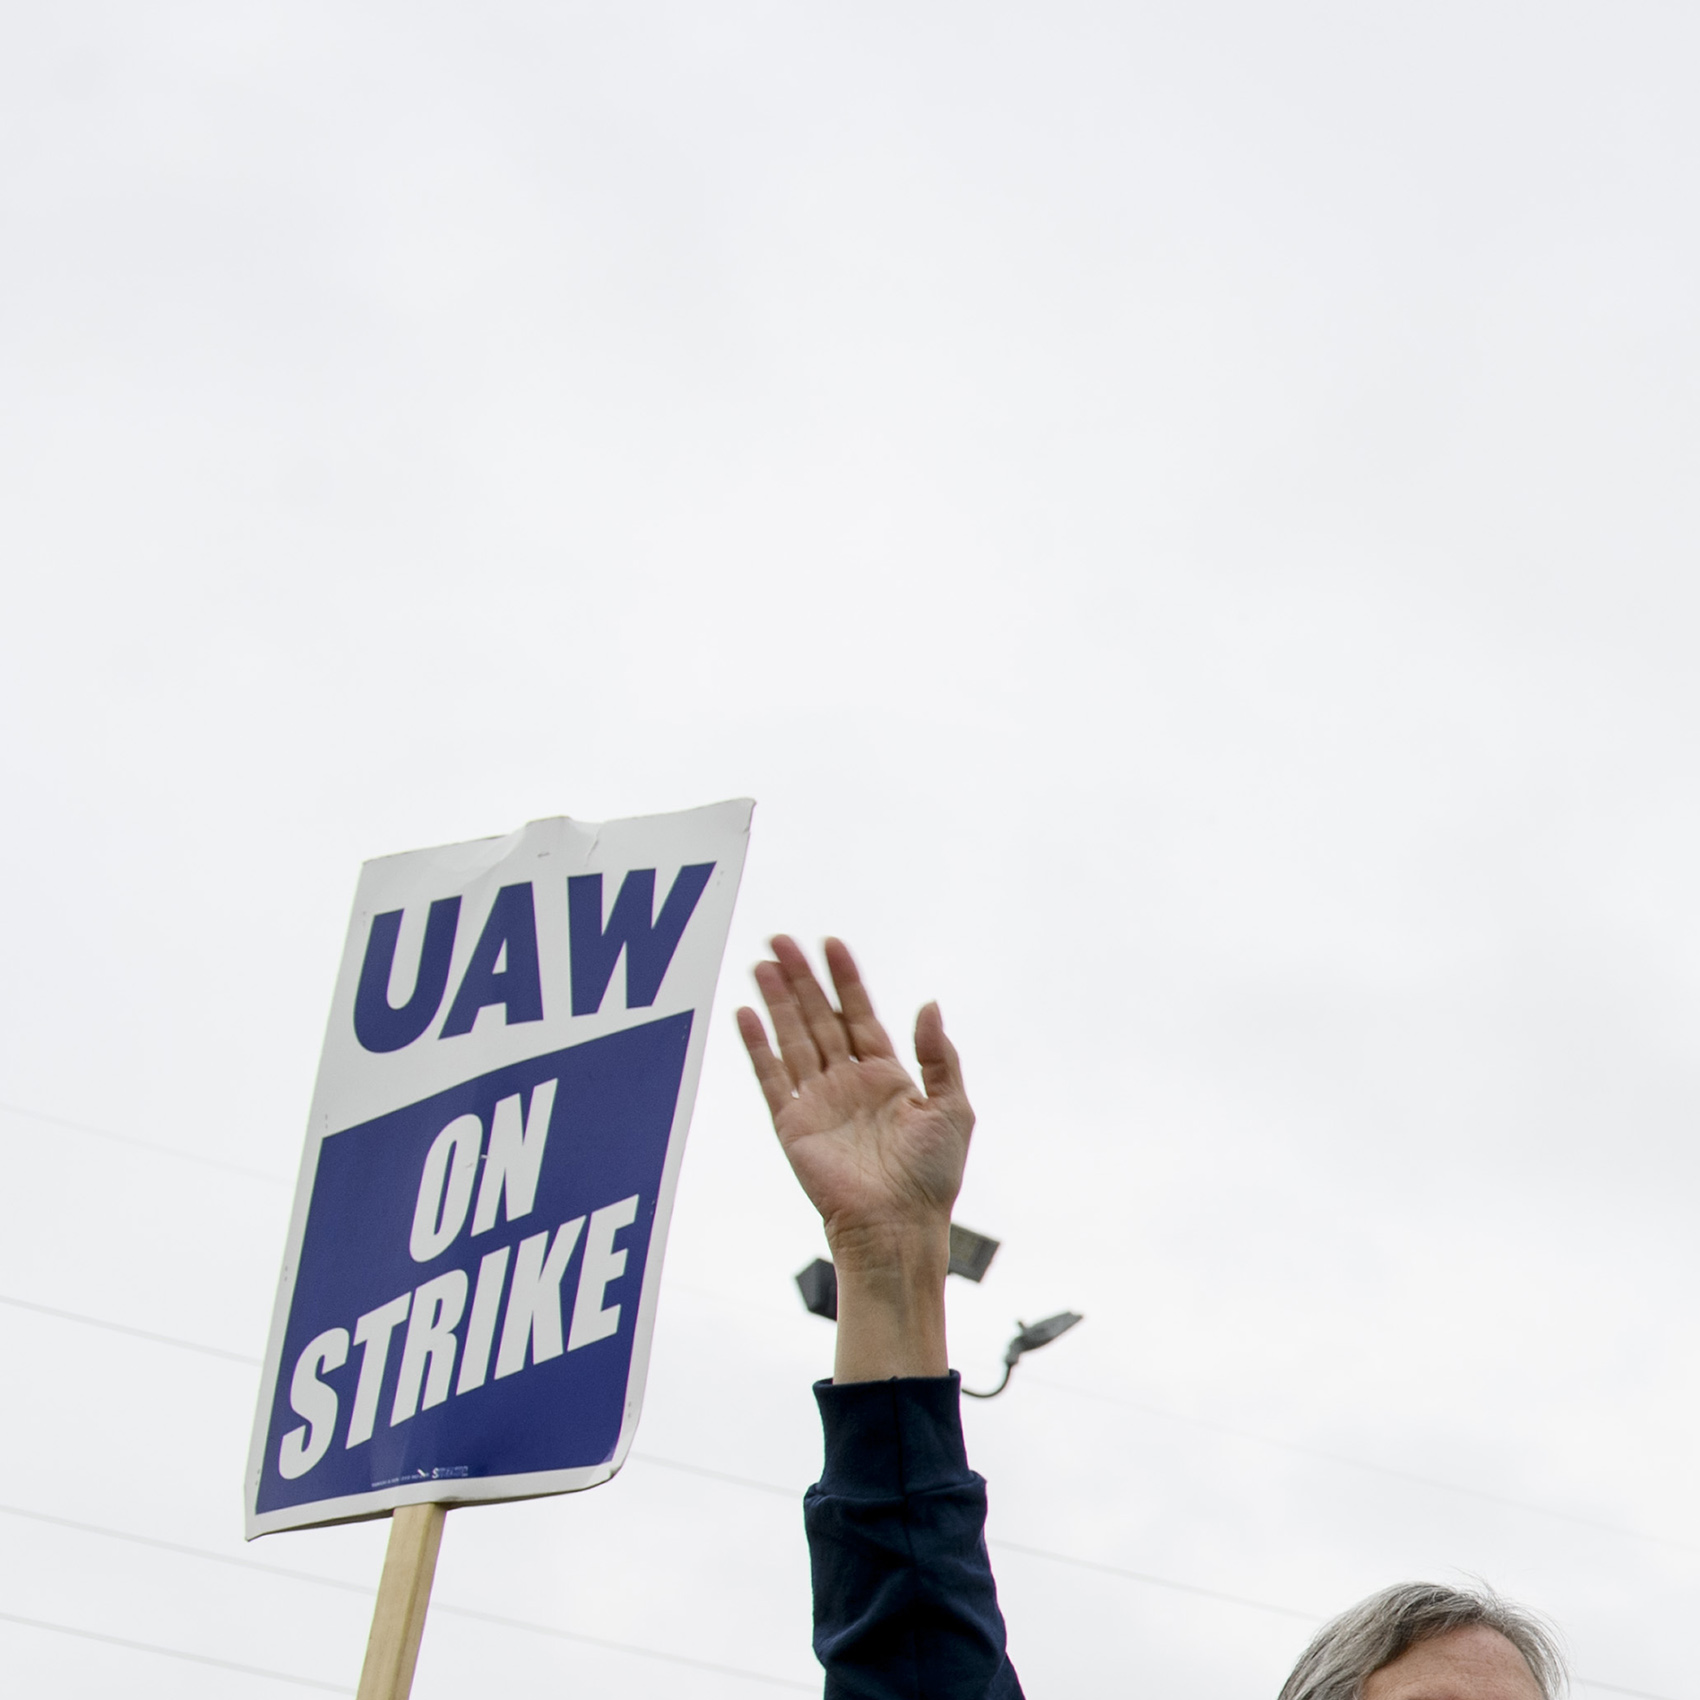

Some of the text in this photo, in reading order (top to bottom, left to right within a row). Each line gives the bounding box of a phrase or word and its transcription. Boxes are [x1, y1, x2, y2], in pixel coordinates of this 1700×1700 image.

[353, 860, 717, 1054] UAW
[409, 1077, 558, 1263] ON
[278, 1193, 639, 1480] STRIKE
